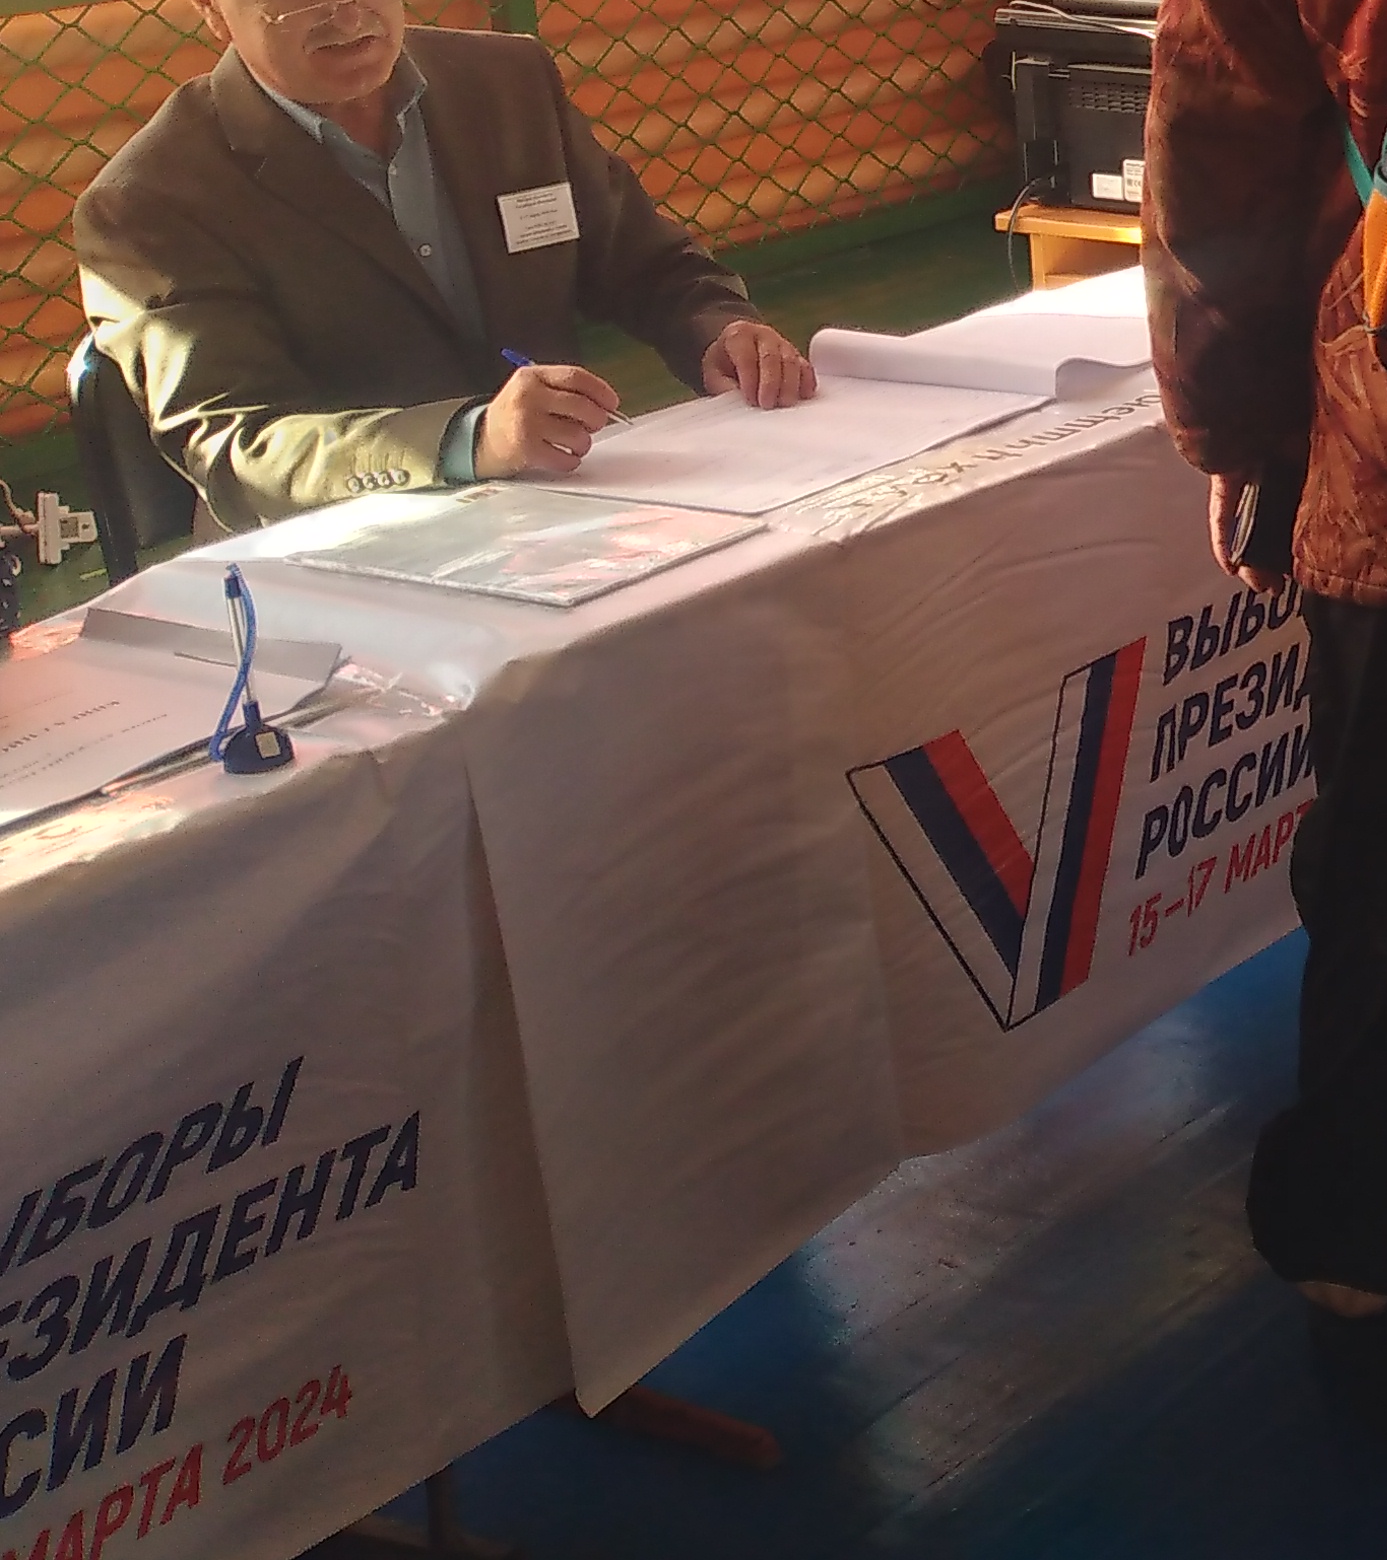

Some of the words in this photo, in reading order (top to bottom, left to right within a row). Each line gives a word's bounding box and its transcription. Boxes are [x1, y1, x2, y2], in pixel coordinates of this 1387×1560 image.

[1163, 578, 1303, 686] ВЫБО
[1149, 644, 1308, 783] ПРЕЗИ
[222, 1365, 353, 1486] 2024
